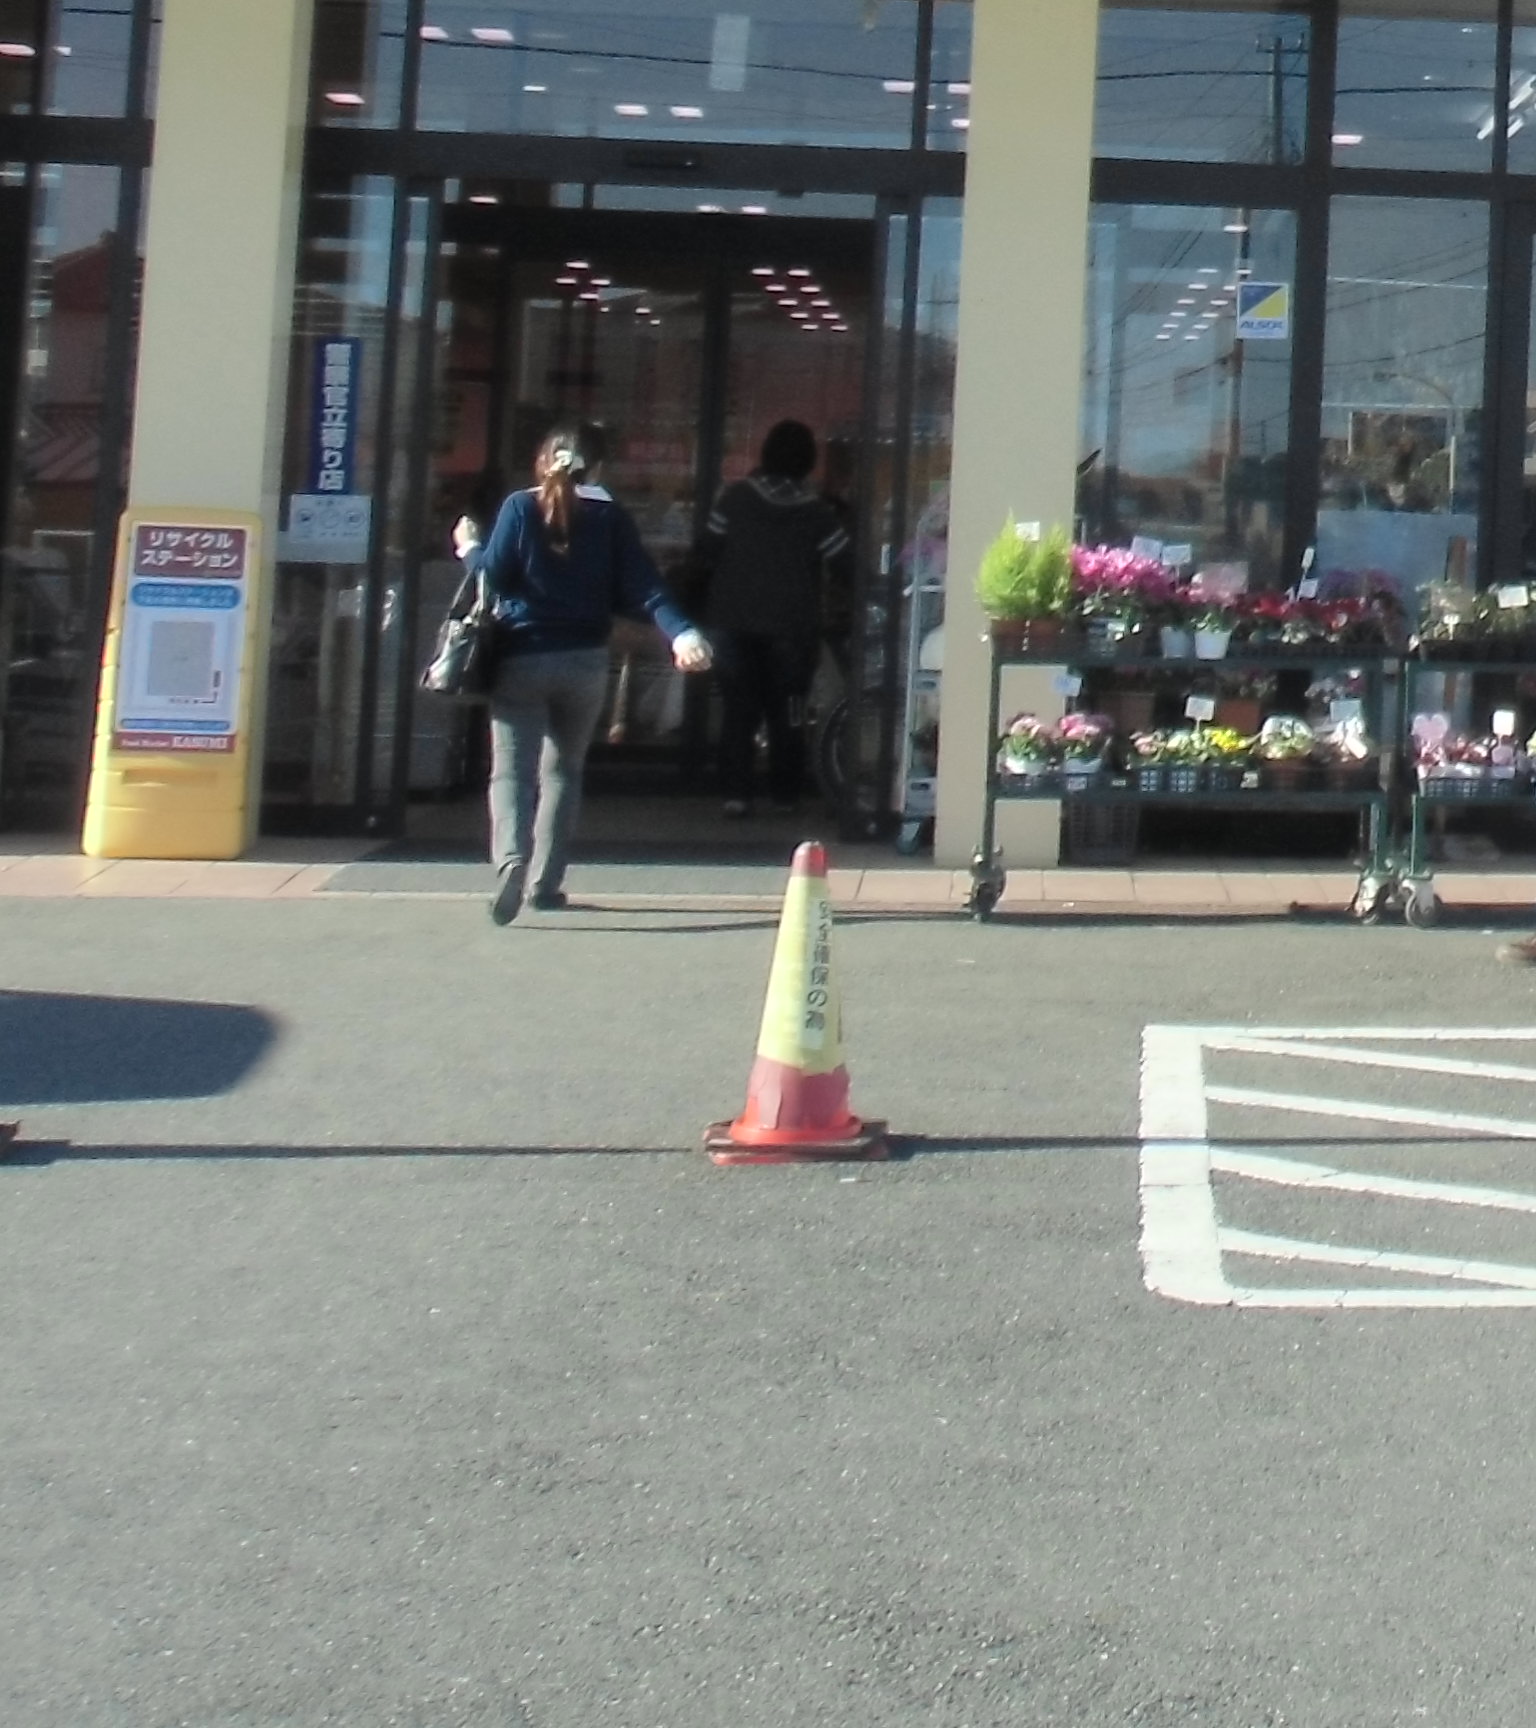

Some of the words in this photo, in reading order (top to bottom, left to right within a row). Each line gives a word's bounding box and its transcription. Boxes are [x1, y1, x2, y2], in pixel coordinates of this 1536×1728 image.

[150, 531, 234, 549] リサイクル
[141, 549, 239, 568] ステーション
